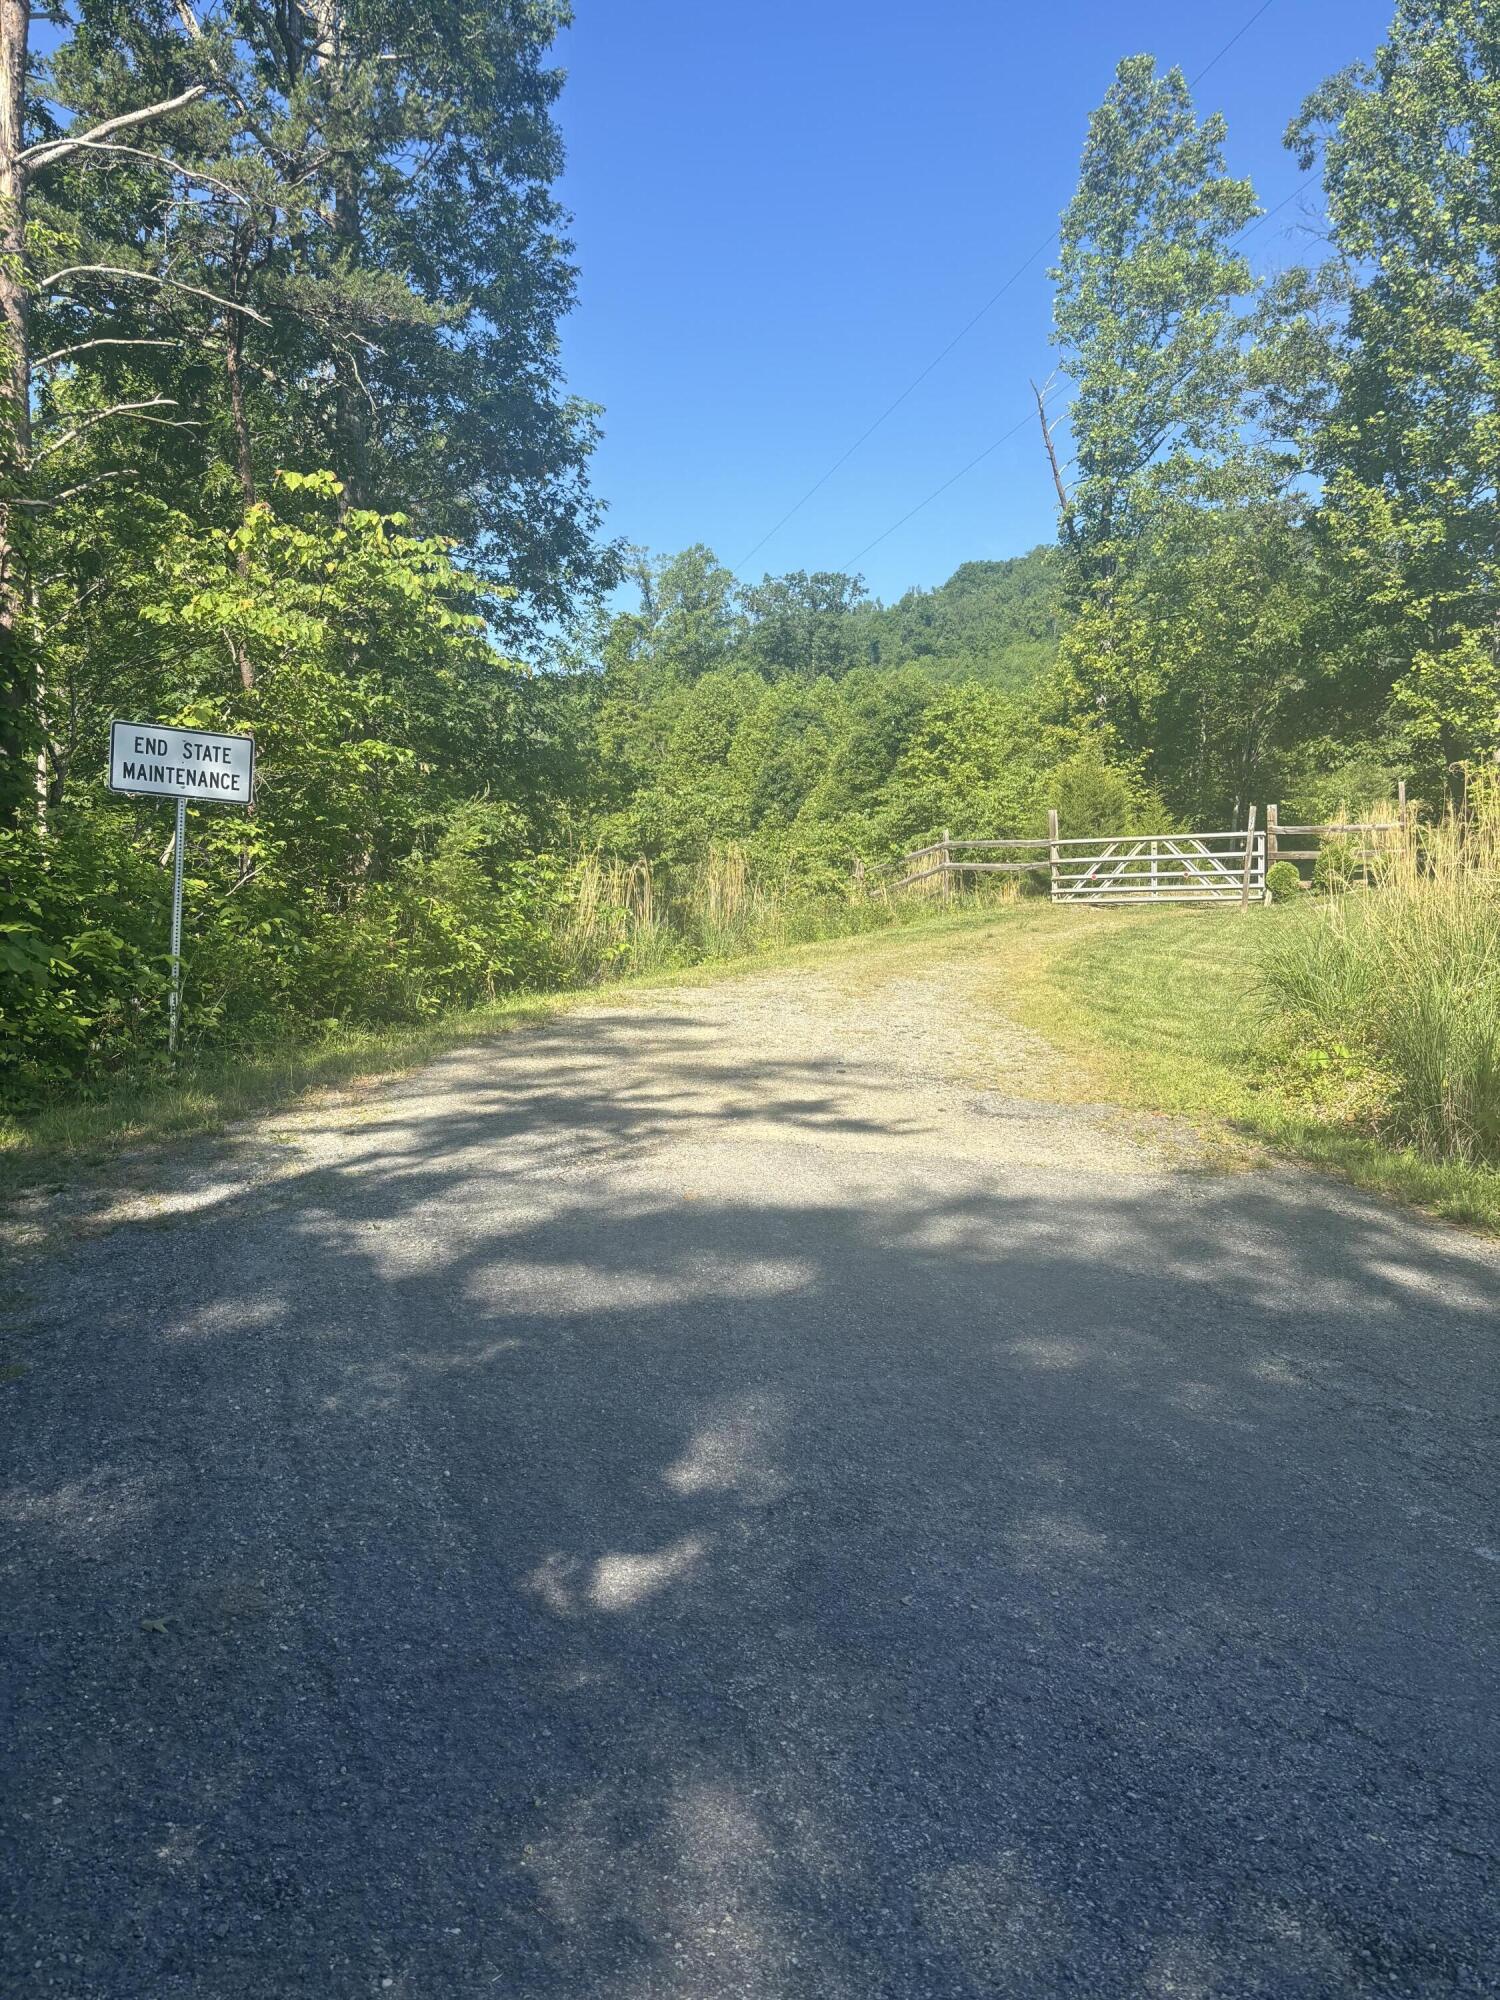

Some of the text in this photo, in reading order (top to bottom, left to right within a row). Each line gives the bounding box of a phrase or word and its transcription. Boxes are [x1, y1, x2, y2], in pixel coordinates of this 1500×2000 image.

[134, 736, 232, 764] END STATE
[122, 761, 240, 791] MAINTENANCE
